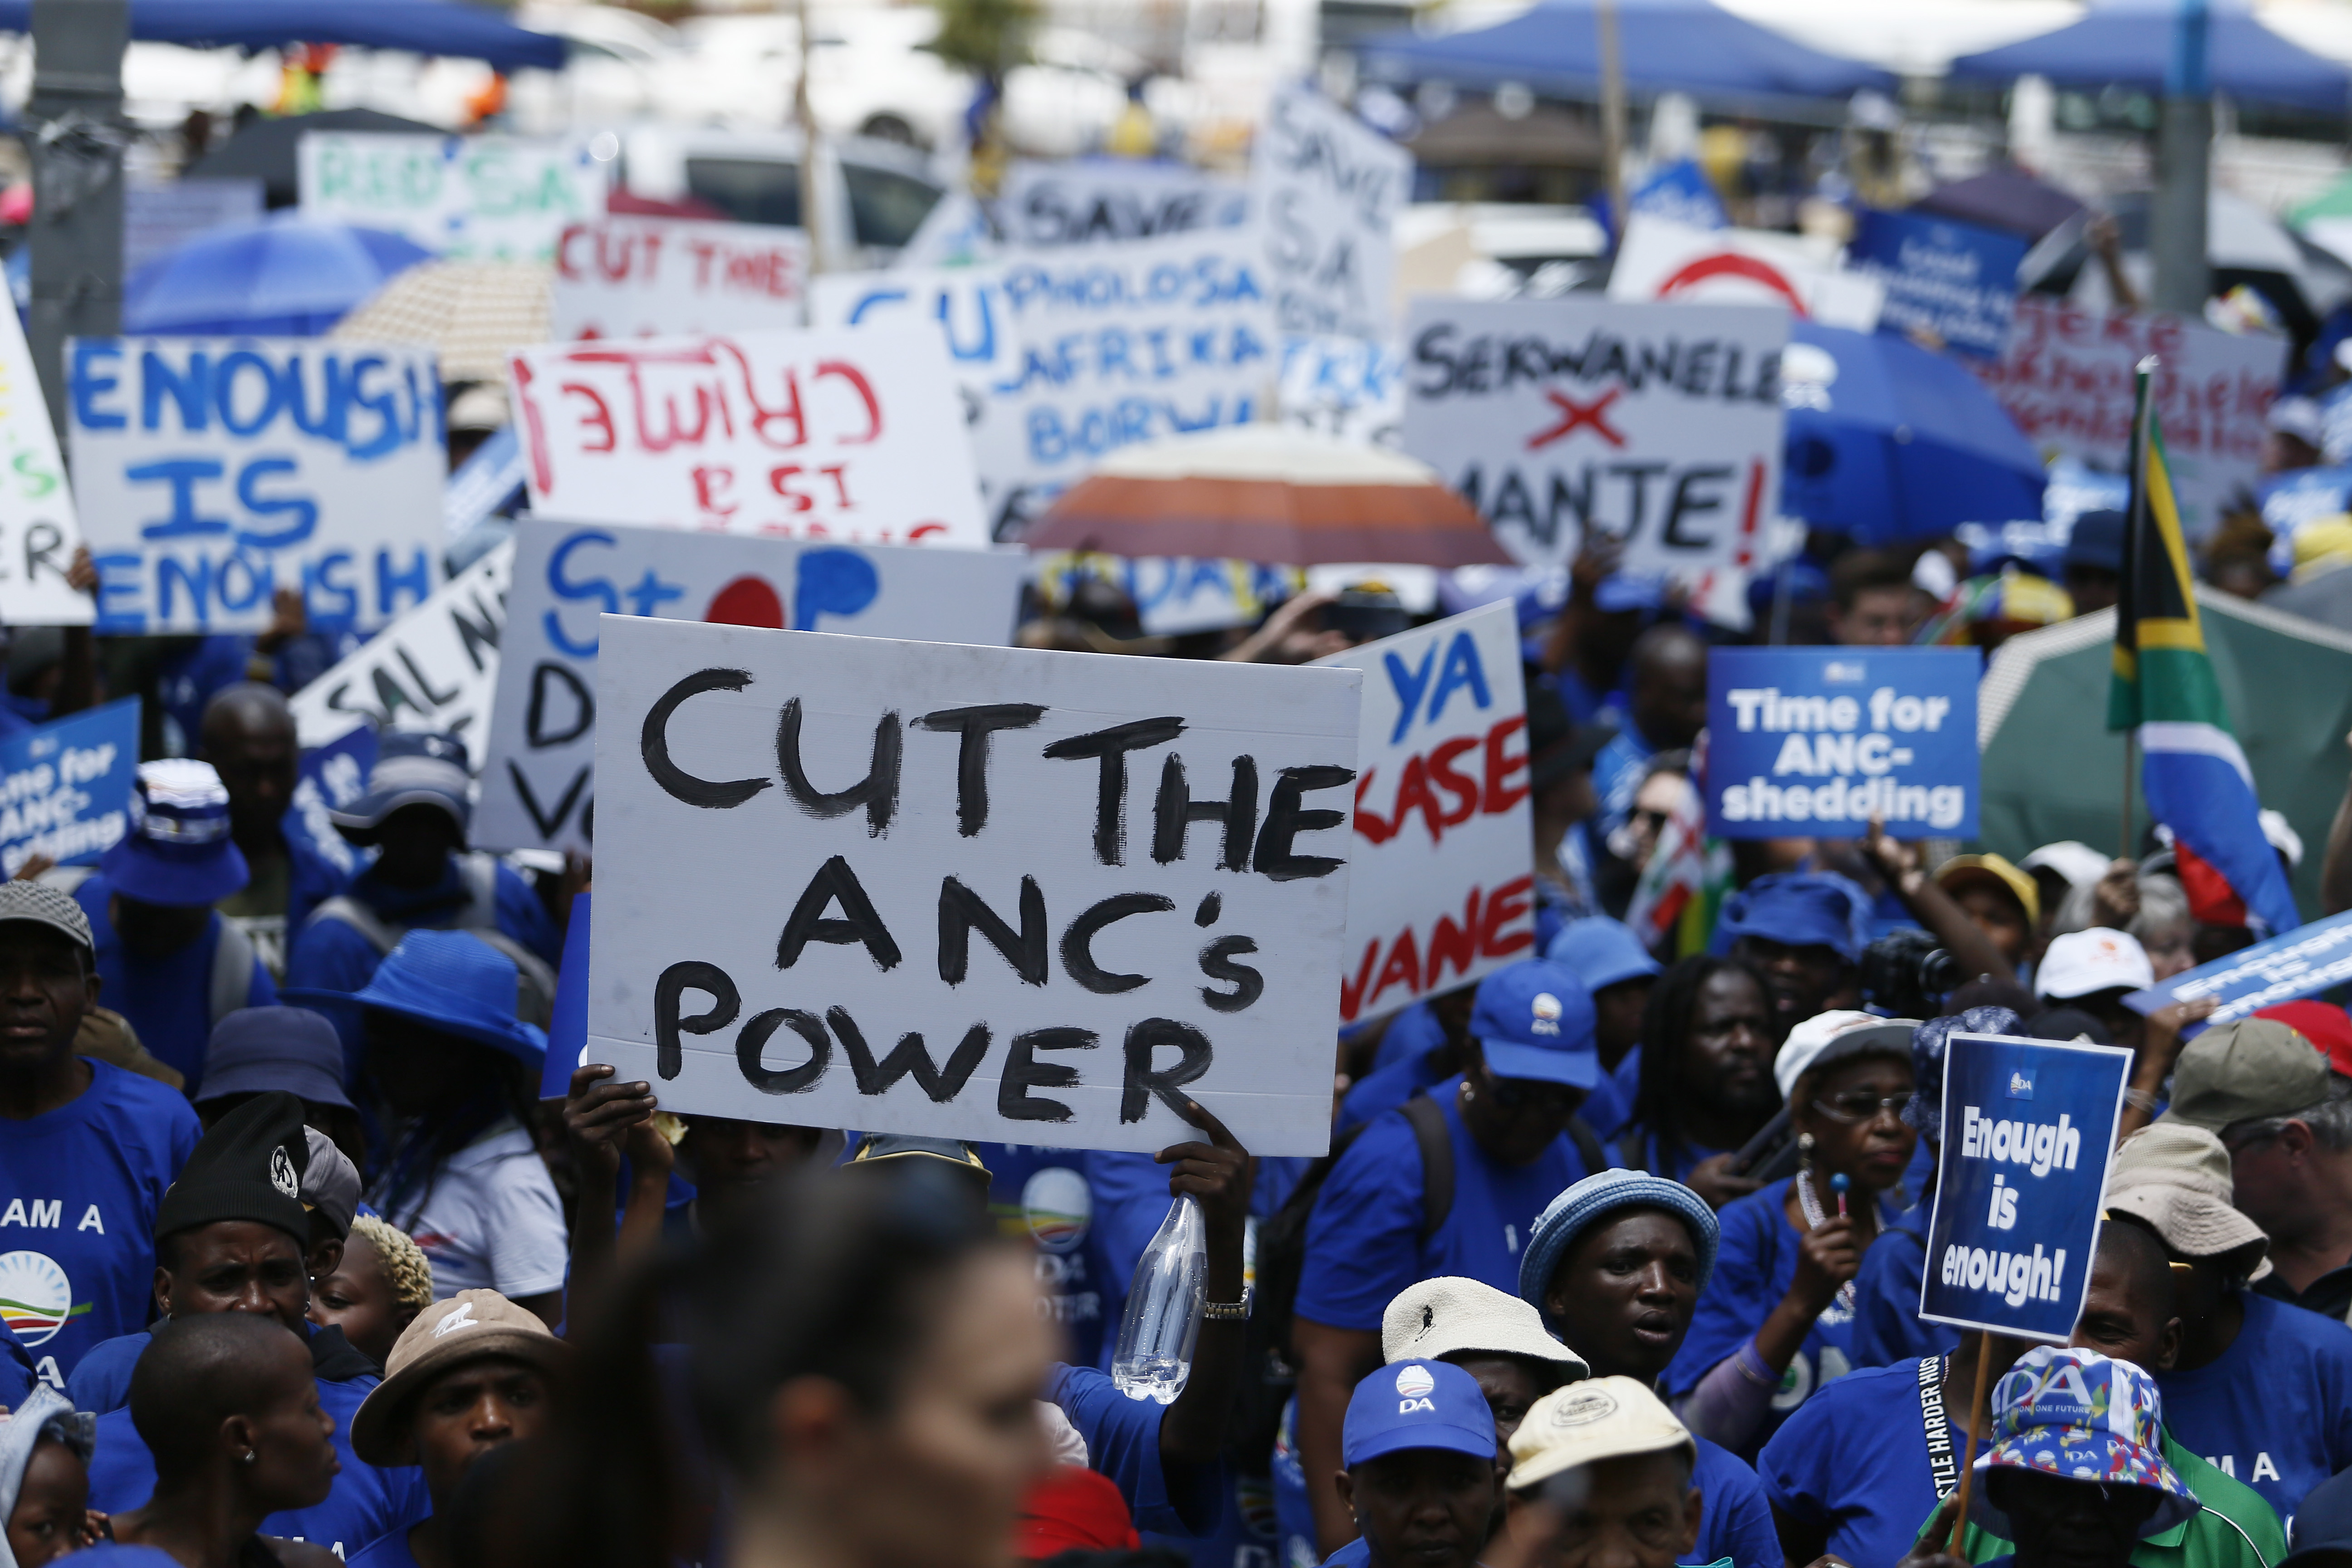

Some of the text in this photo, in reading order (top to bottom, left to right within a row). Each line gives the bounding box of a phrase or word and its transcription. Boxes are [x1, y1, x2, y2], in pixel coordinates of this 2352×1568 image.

[123, 456, 320, 550] IS
[1383, 628, 1492, 745] YA
[1725, 685, 1950, 733] Time for
[640, 665, 1358, 882] CUT THE
[1771, 731, 1915, 778] ANC-
[1720, 774, 1965, 830] shedding
[653, 959, 1214, 1125] POWER
[2018, 1078, 2034, 1092] DA
[1960, 1104, 2080, 1178] Enough
[0, 1197, 105, 1235] AM A
[1986, 1172, 2020, 1230] is
[1941, 1243, 2067, 1307] enough!
[1398, 1396, 1436, 1415] DA
[2001, 1364, 2093, 1415] DA
[2034, 1404, 2053, 1413] ONE
[1919, 1383, 1951, 1454] HARDER
[2251, 1451, 2281, 1483] A
